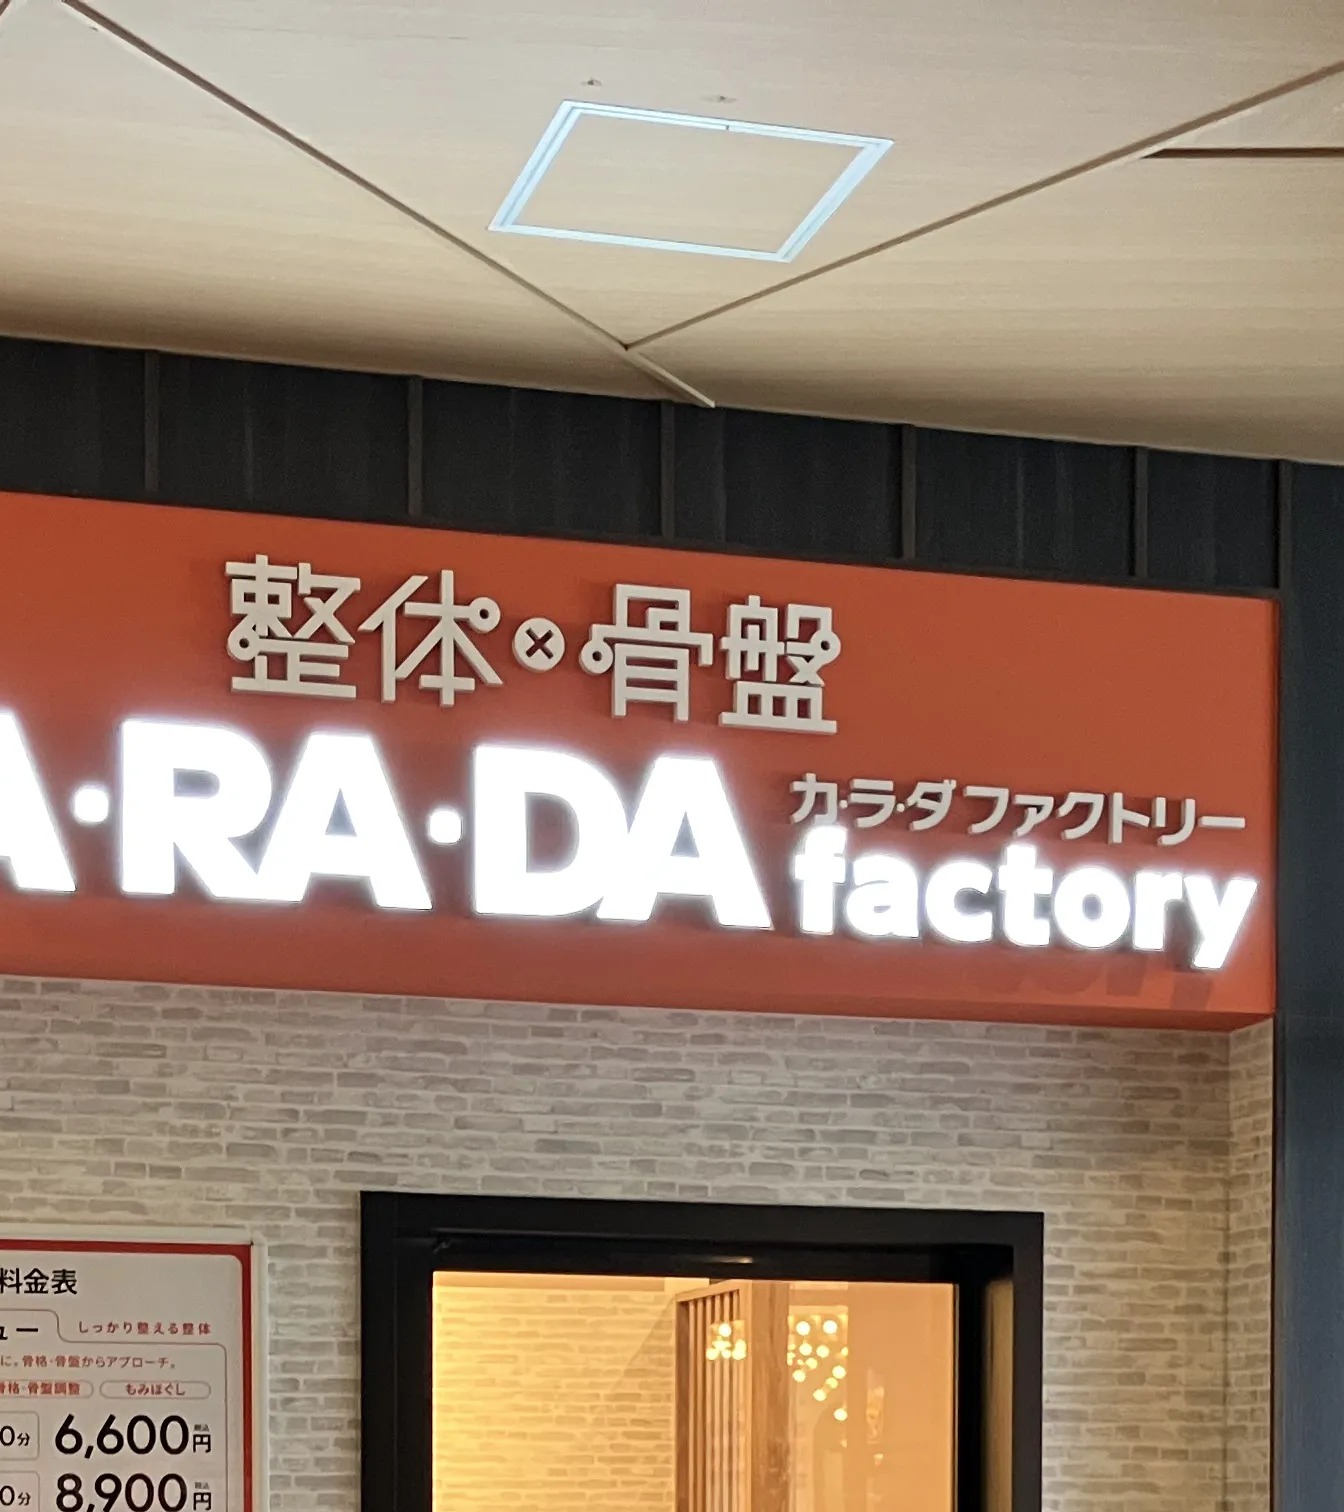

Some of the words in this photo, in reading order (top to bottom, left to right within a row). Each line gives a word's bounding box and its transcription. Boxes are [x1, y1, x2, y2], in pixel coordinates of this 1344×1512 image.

[793, 826, 1258, 970] factory
[78, 1320, 212, 1336] しっかり整える整体
[125, 1383, 186, 1397] もみほぐし
